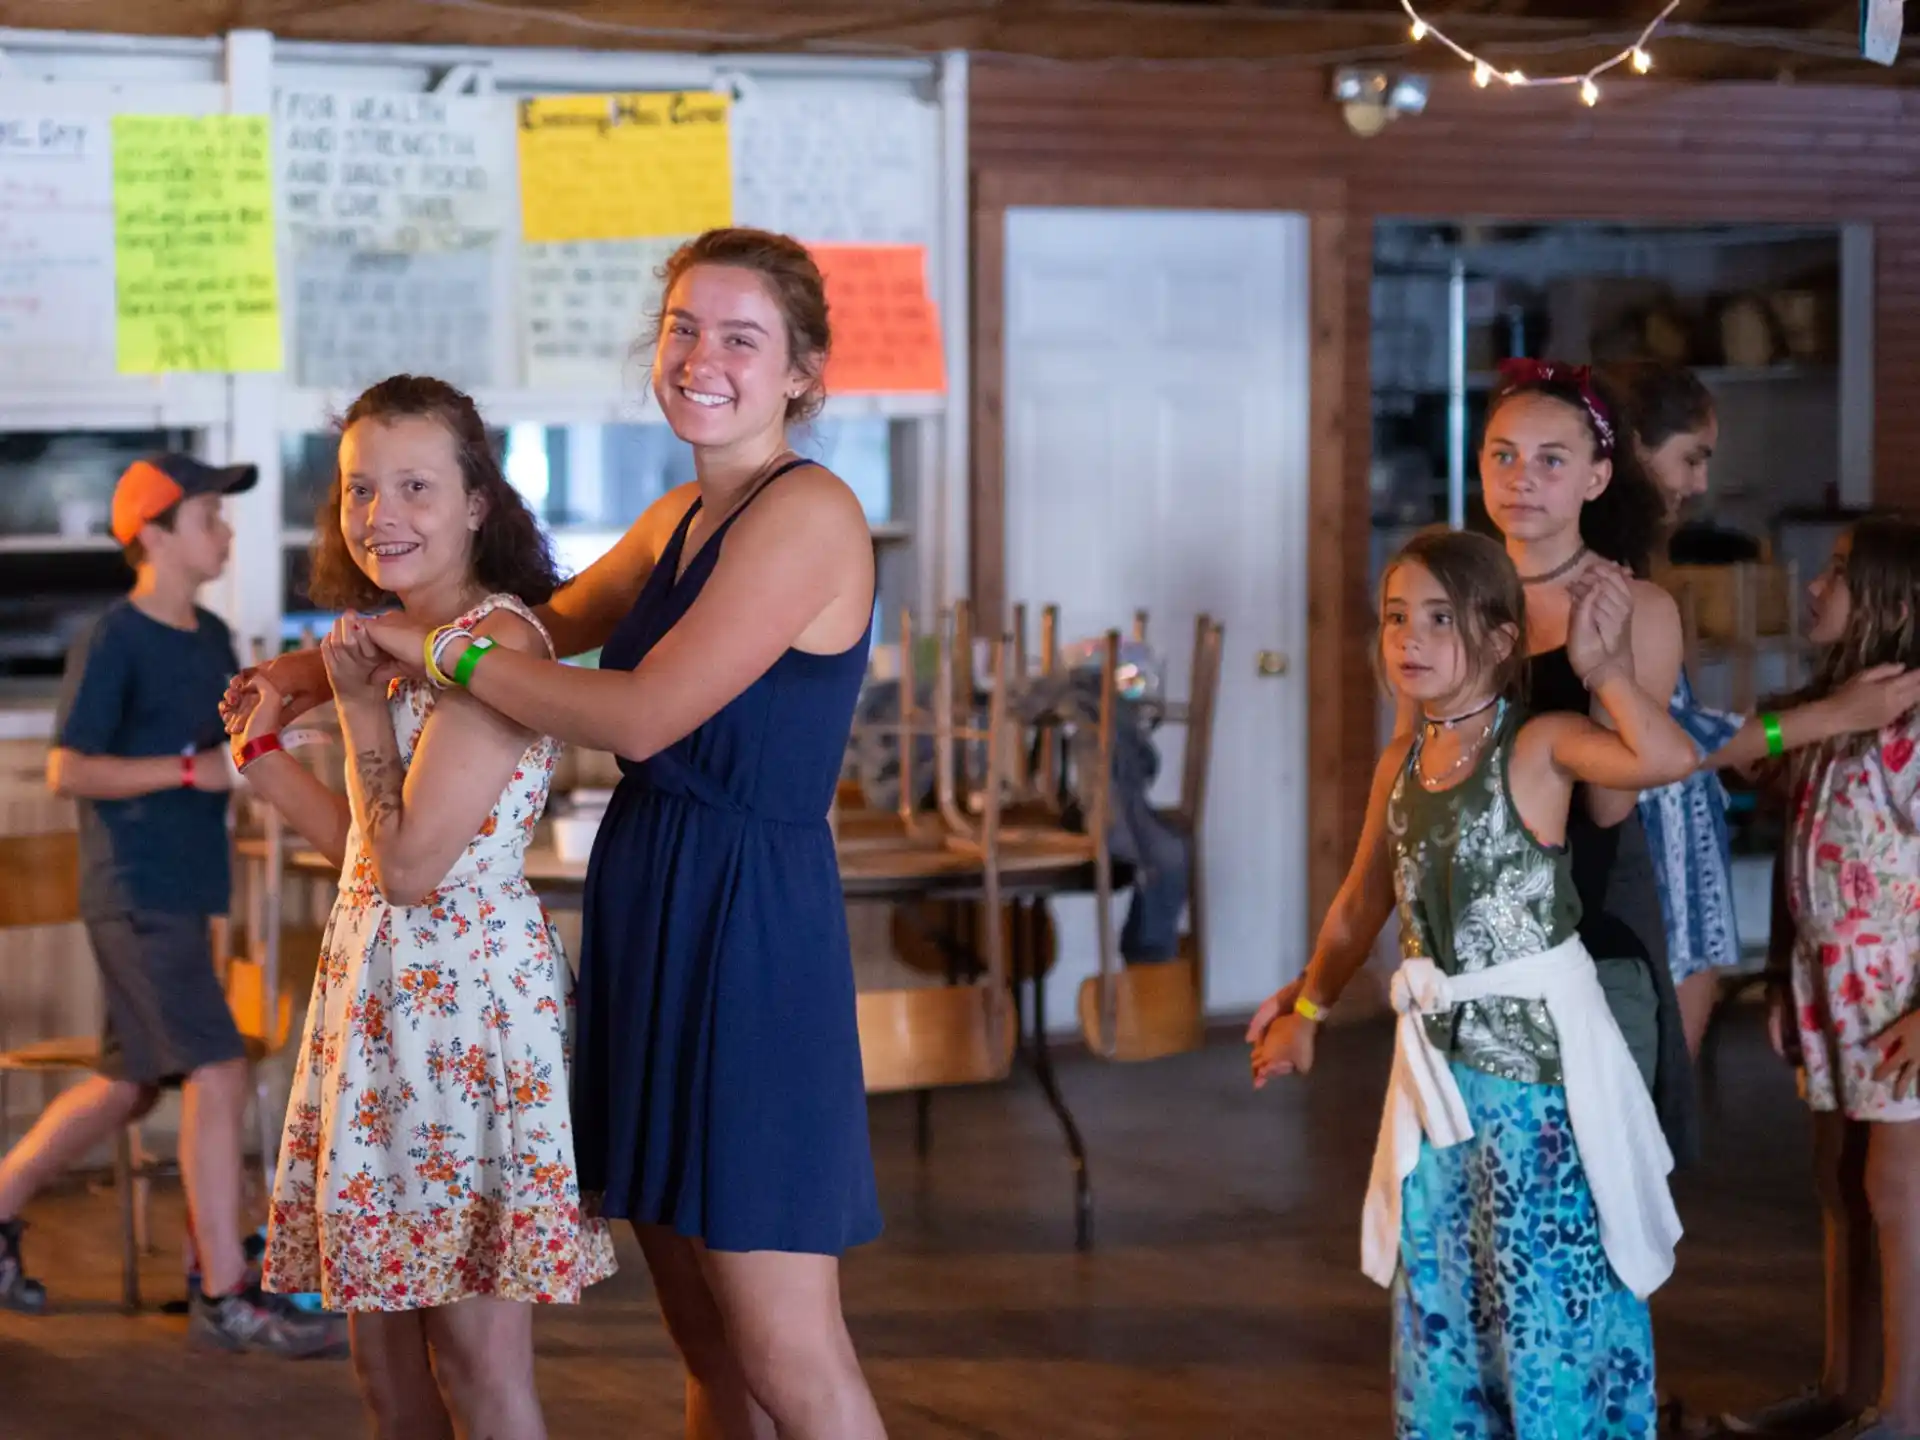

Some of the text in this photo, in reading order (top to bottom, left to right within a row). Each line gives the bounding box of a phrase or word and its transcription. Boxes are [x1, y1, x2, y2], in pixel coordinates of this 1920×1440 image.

[286, 93, 447, 124] FOR HEALTH
[286, 126, 333, 152] AND
[343, 128, 476, 156] STRENGTH
[286, 160, 329, 184] AND
